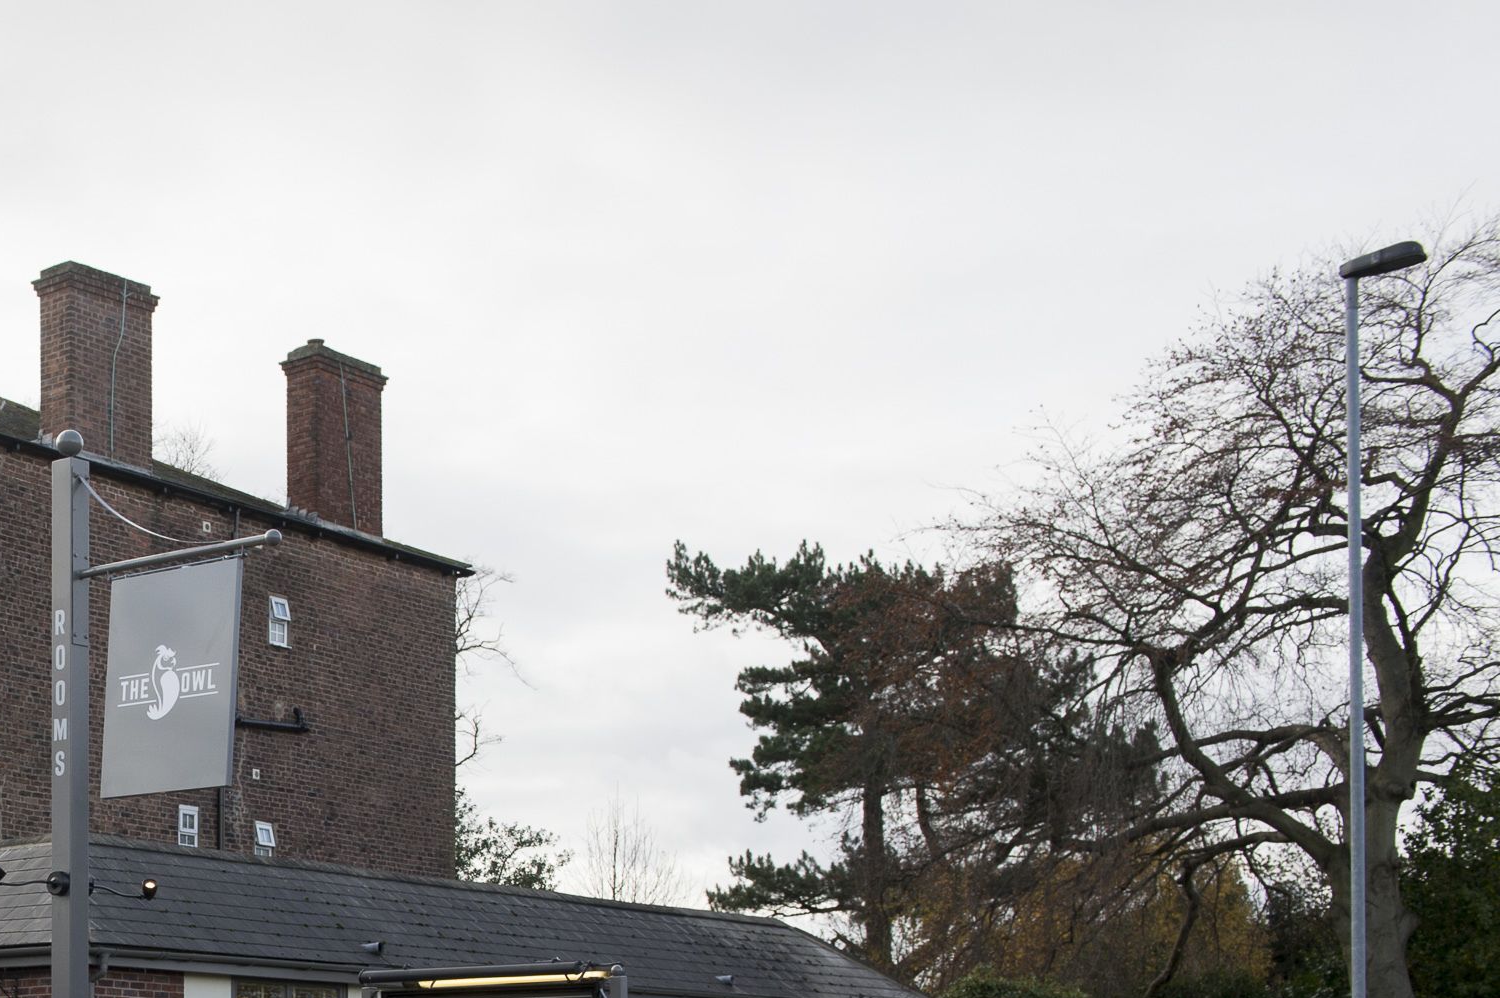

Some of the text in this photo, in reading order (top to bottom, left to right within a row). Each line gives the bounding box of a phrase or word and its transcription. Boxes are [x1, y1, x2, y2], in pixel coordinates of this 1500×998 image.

[53, 609, 68, 776] ROOMS
[120, 669, 216, 701] THE OWL
